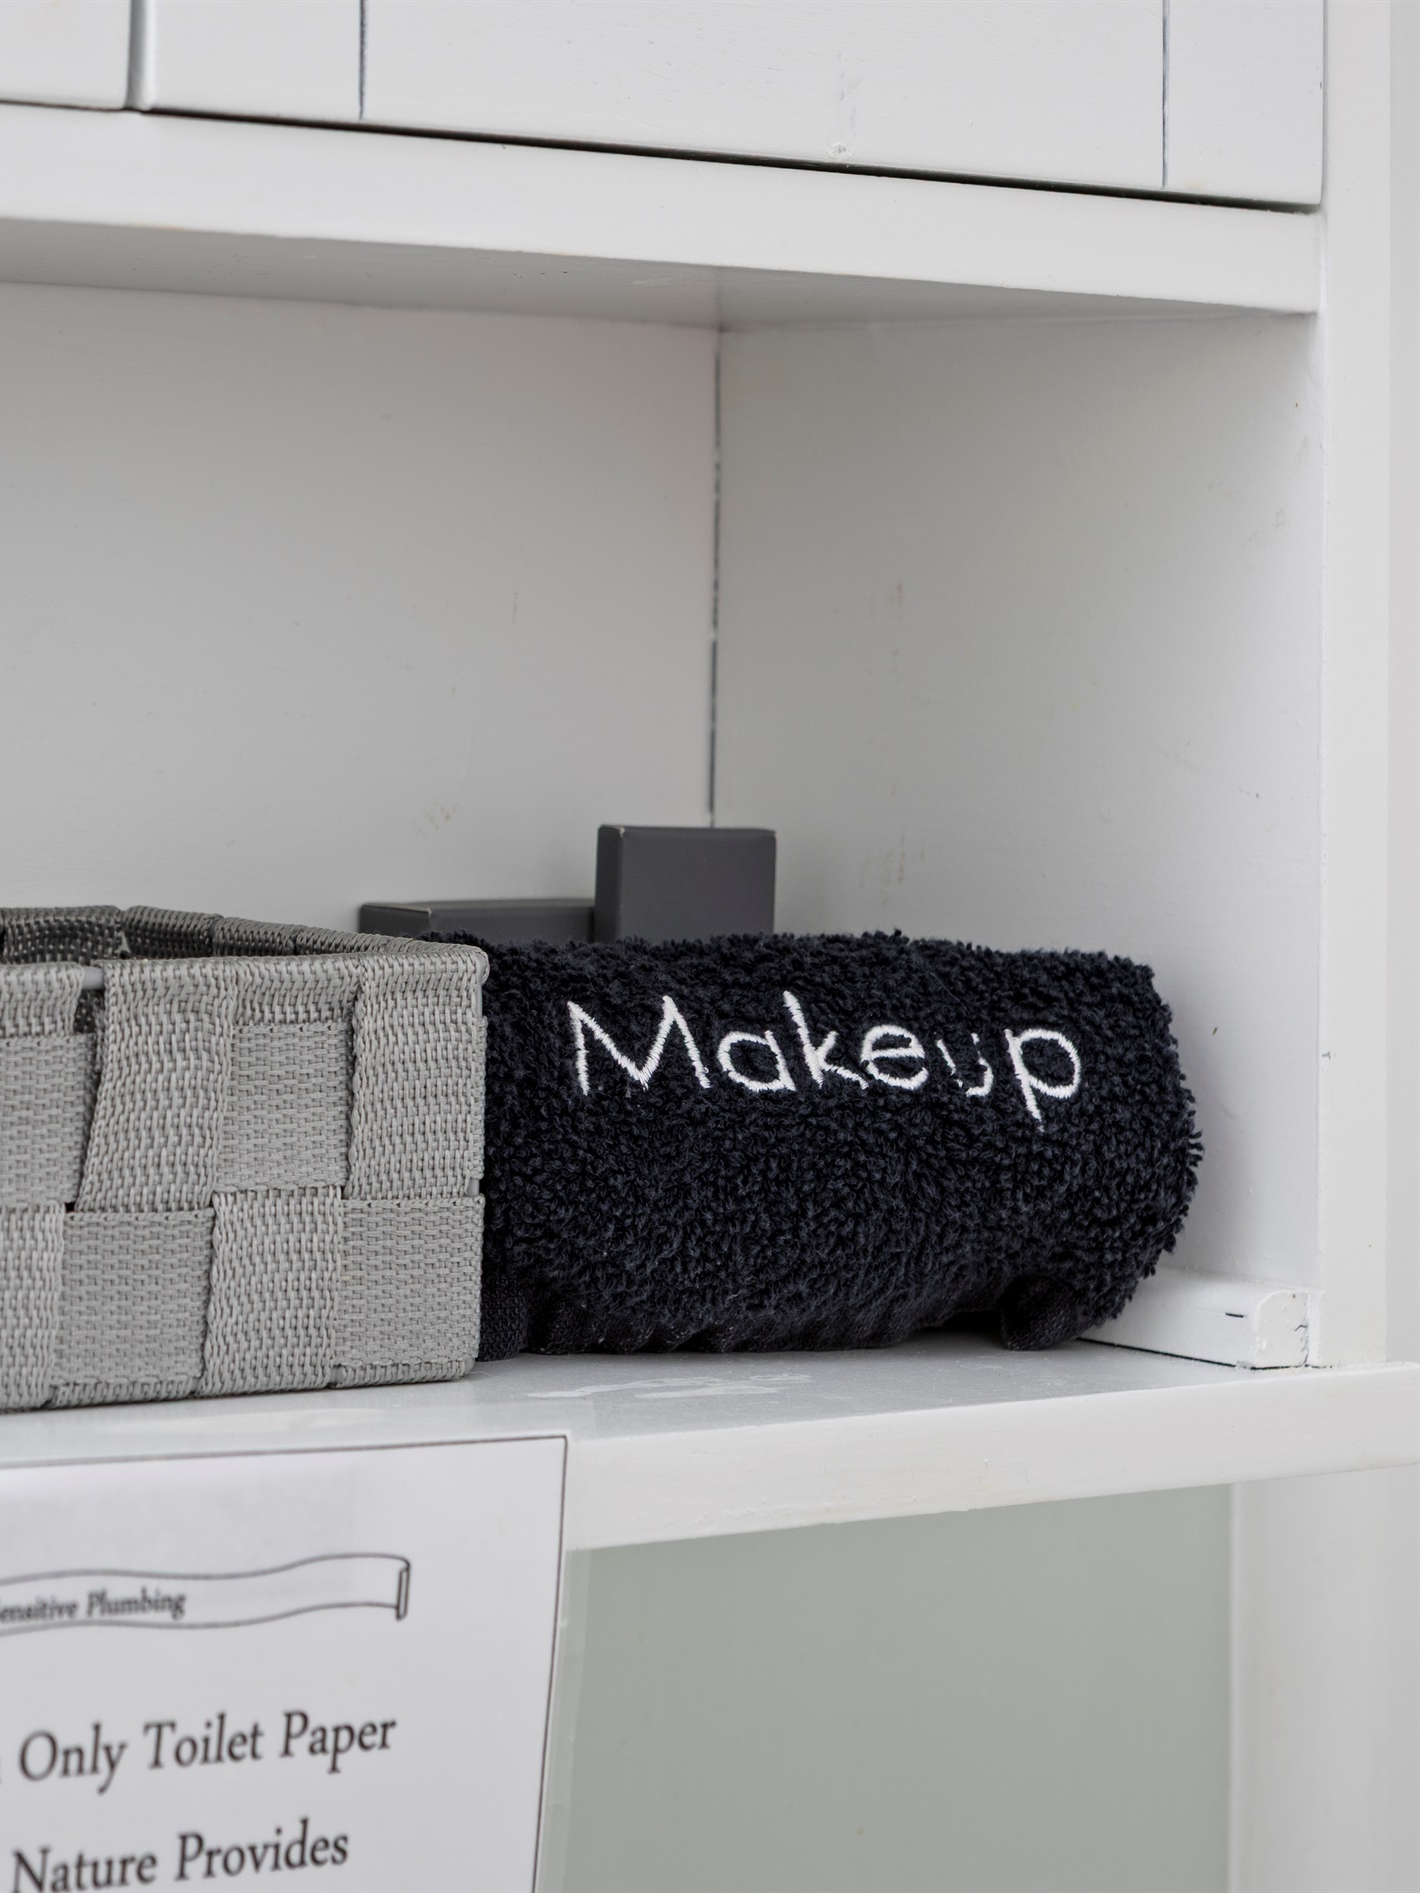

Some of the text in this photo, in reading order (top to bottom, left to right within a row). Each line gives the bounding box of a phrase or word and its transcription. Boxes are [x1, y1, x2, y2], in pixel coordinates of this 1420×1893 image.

[566, 990, 1081, 1132] Makeup
[86, 1586, 186, 1620] Plumbing
[18, 1720, 128, 1795] Only
[142, 1711, 264, 1769] Toilet
[279, 1709, 396, 1774] Paper
[11, 1846, 158, 1893] Nature
[174, 1815, 349, 1881] Provides
